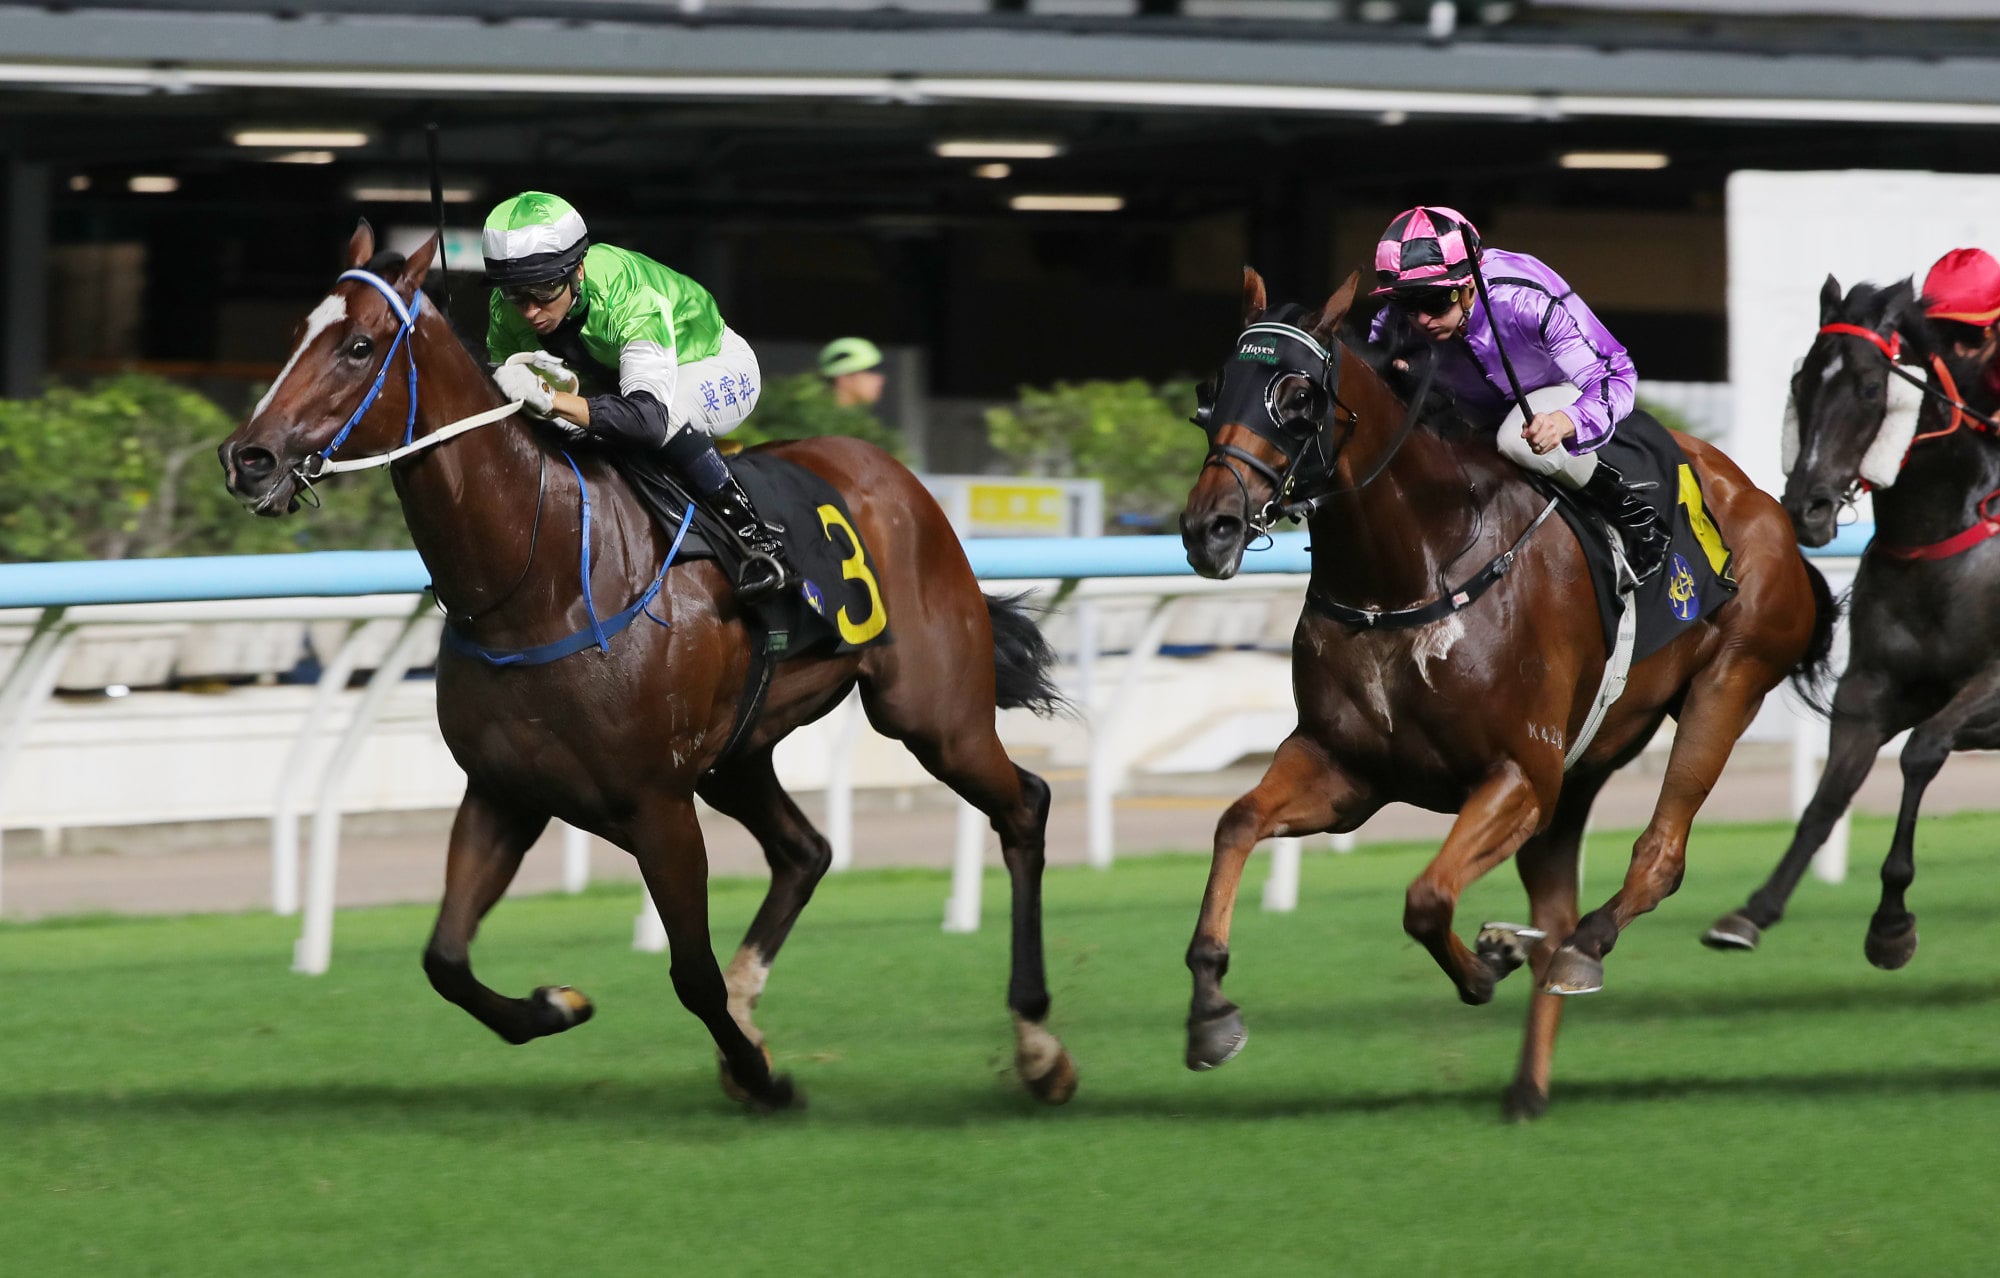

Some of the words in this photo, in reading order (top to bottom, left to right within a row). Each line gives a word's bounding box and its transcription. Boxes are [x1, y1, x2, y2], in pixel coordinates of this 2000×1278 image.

[1240, 344, 1275, 355] Hayes
[699, 372, 755, 412] 莫雷拉
[816, 503, 887, 645] 3
